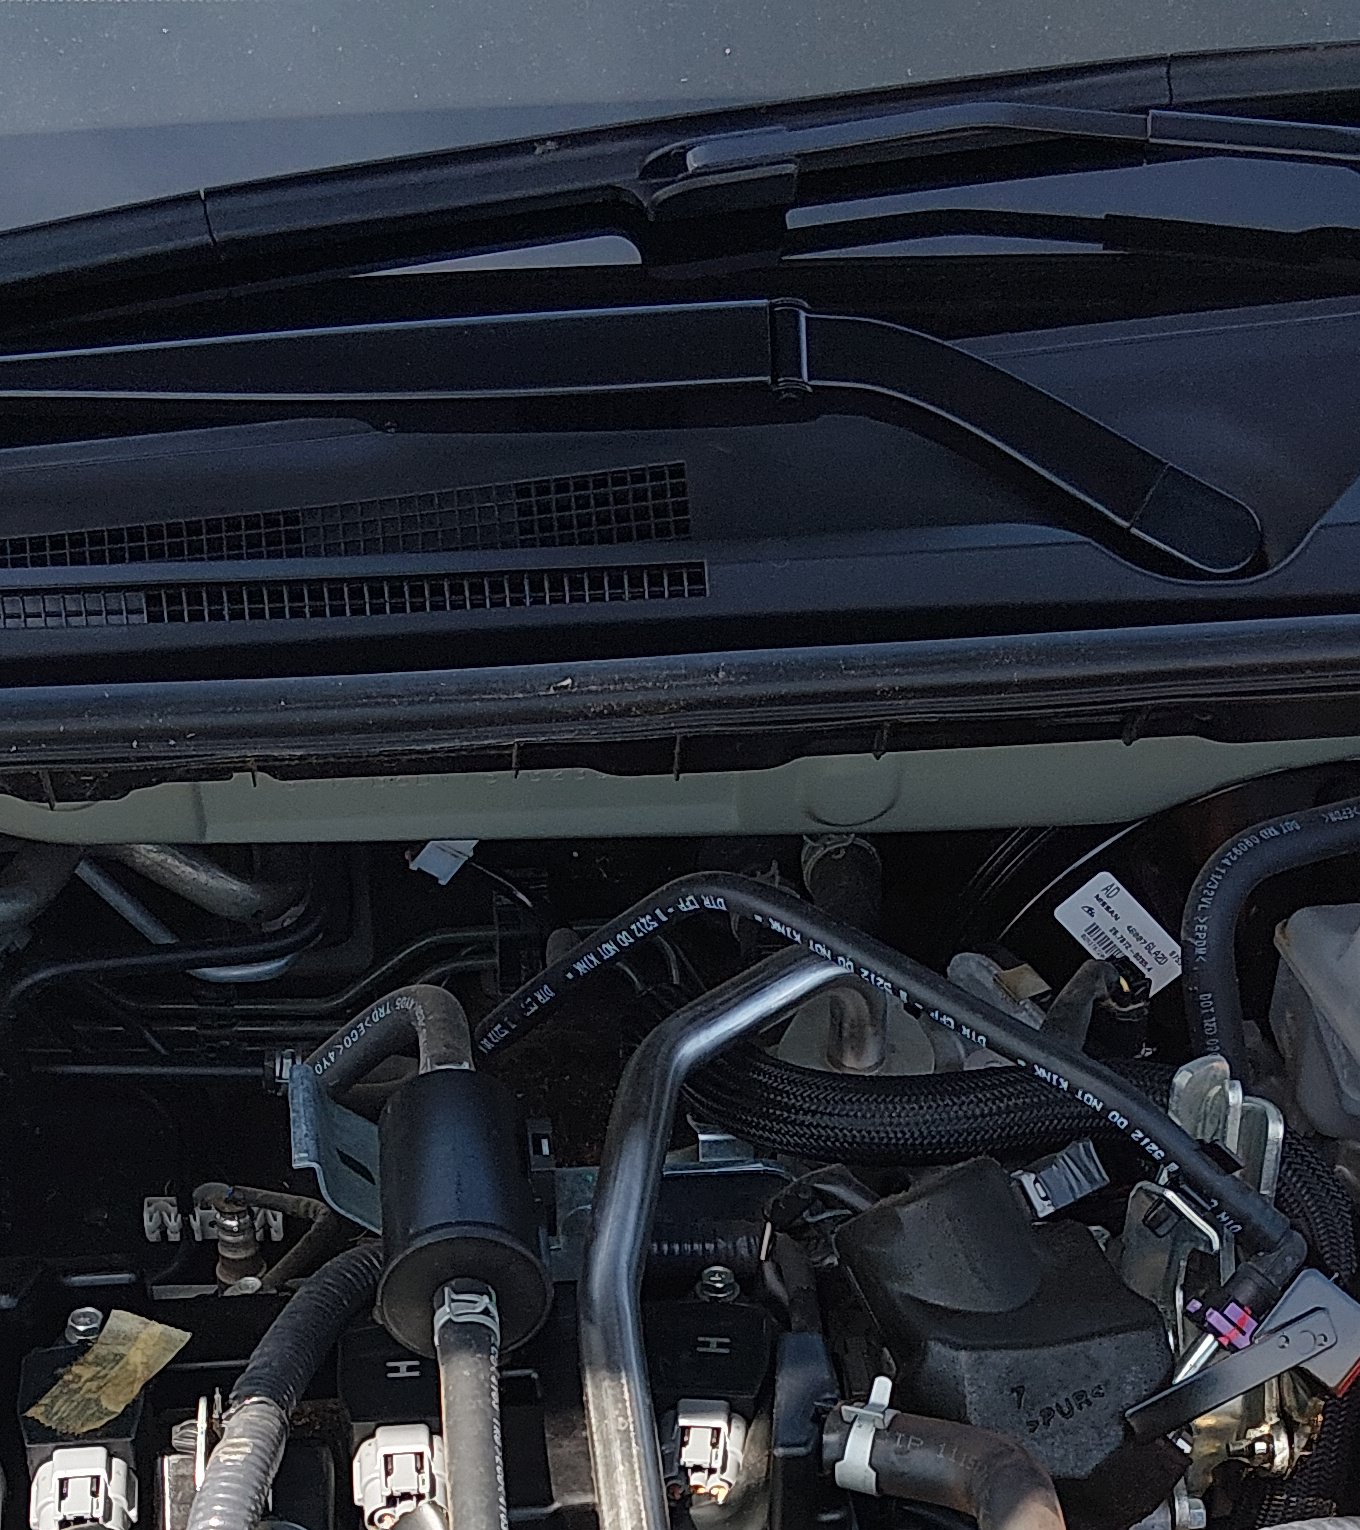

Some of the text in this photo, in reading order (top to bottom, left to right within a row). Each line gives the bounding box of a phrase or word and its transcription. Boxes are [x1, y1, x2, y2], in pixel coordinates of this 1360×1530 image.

[1099, 880, 1122, 900] AD
[1091, 892, 1123, 922] NISSAN
[616, 929, 634, 947] DO
[768, 916, 802, 944] KINK
[597, 939, 620, 961] NOT
[808, 938, 832, 961] NOT
[572, 953, 602, 977] KINK
[837, 956, 854, 973] DO
[1033, 1063, 1069, 1091] KINK
[1075, 1089, 1104, 1112] NOT
[1107, 1110, 1130, 1130] DO
[385, 1360, 421, 1378] H
